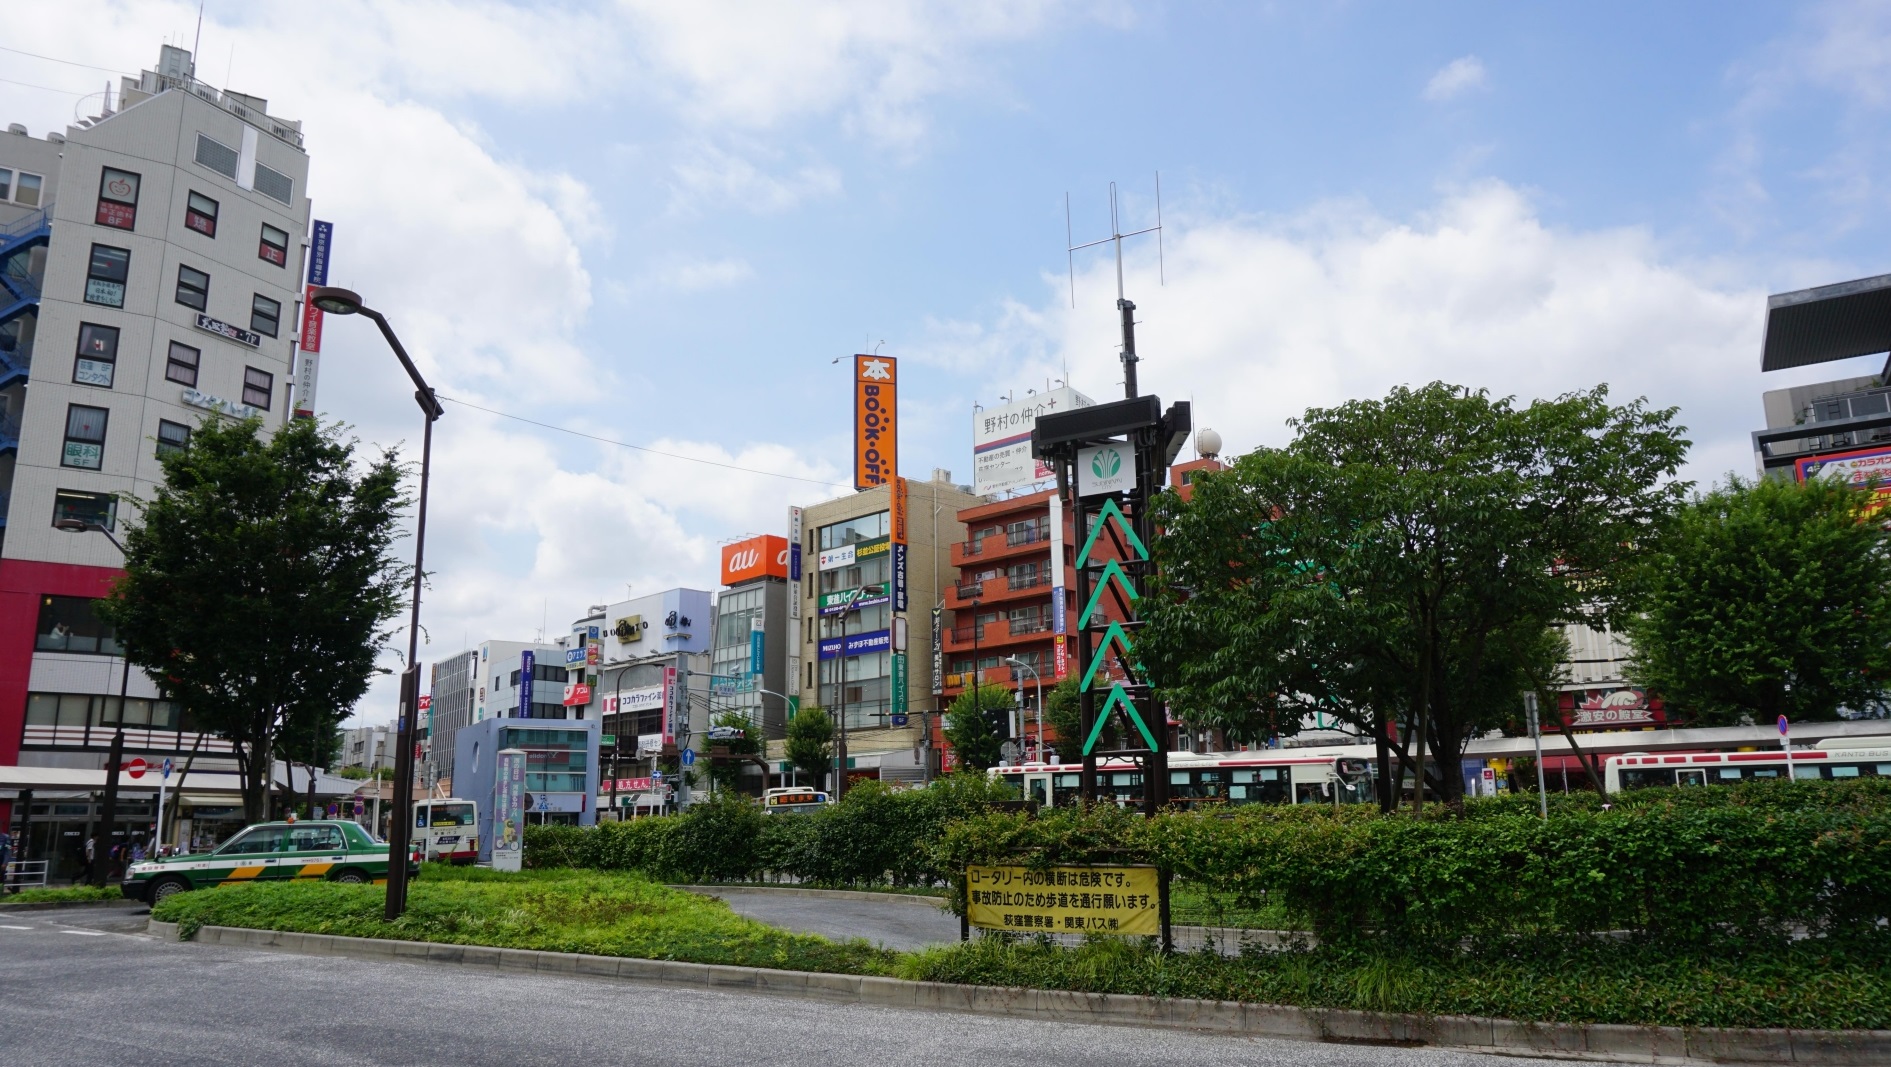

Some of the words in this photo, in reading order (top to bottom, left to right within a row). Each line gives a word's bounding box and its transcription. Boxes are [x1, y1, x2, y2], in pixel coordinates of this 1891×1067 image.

[267, 246, 278, 262] 正
[314, 233, 325, 283] 東京個別指導学院
[305, 305, 319, 350] ワイ音楽教室
[863, 359, 890, 380] 本
[67, 443, 99, 459] 眼科
[729, 549, 759, 572] au
[828, 551, 853, 563] 第一生命
[822, 643, 842, 652] MIZUHO
[848, 636, 889, 649] みずほ不動産販売
[576, 687, 588, 695] アコム
[1580, 711, 1644, 722] 激安の殿堂
[971, 870, 1131, 888] ロータリー内の横断は危険です。
[971, 890, 1156, 910] 事故防止のため歩道を通行願います。
